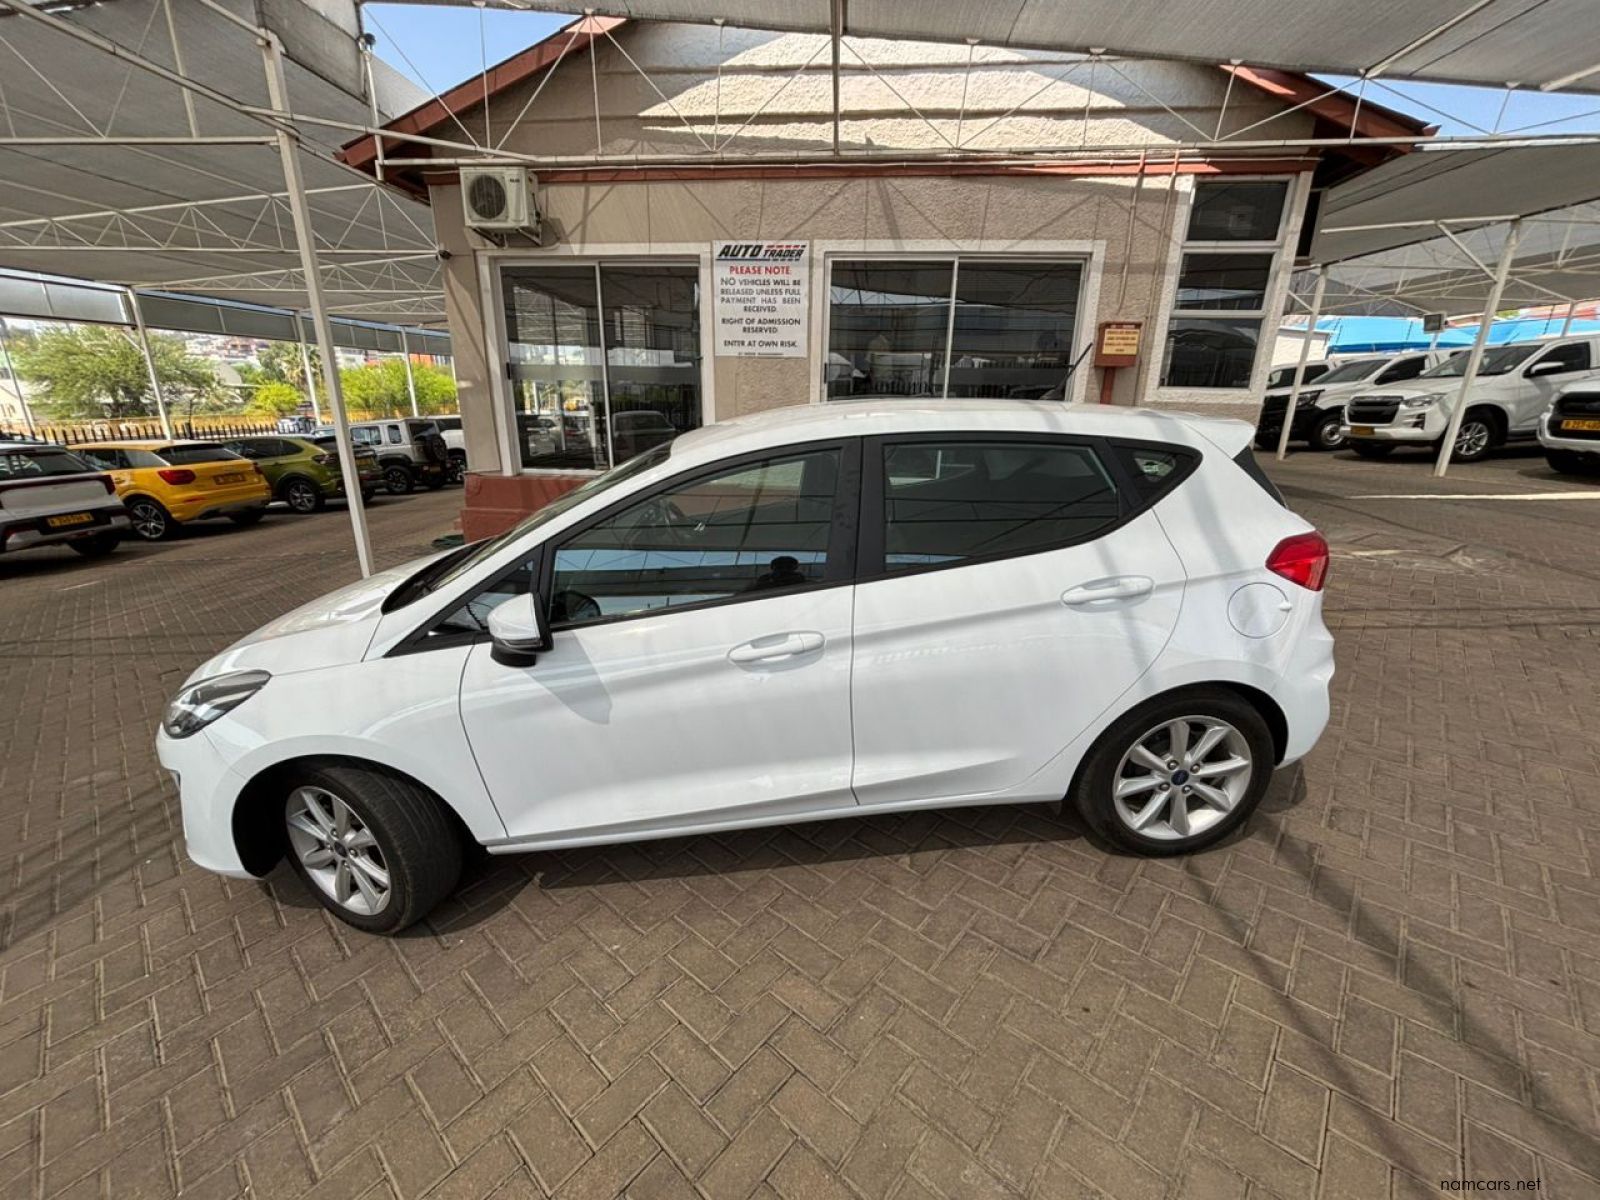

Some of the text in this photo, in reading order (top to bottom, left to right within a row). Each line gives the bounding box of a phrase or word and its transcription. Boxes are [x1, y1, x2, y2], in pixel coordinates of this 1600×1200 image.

[718, 245, 804, 257] AUTO TRADER
[729, 266, 761, 275] PLEASE
[720, 277, 736, 286] NO
